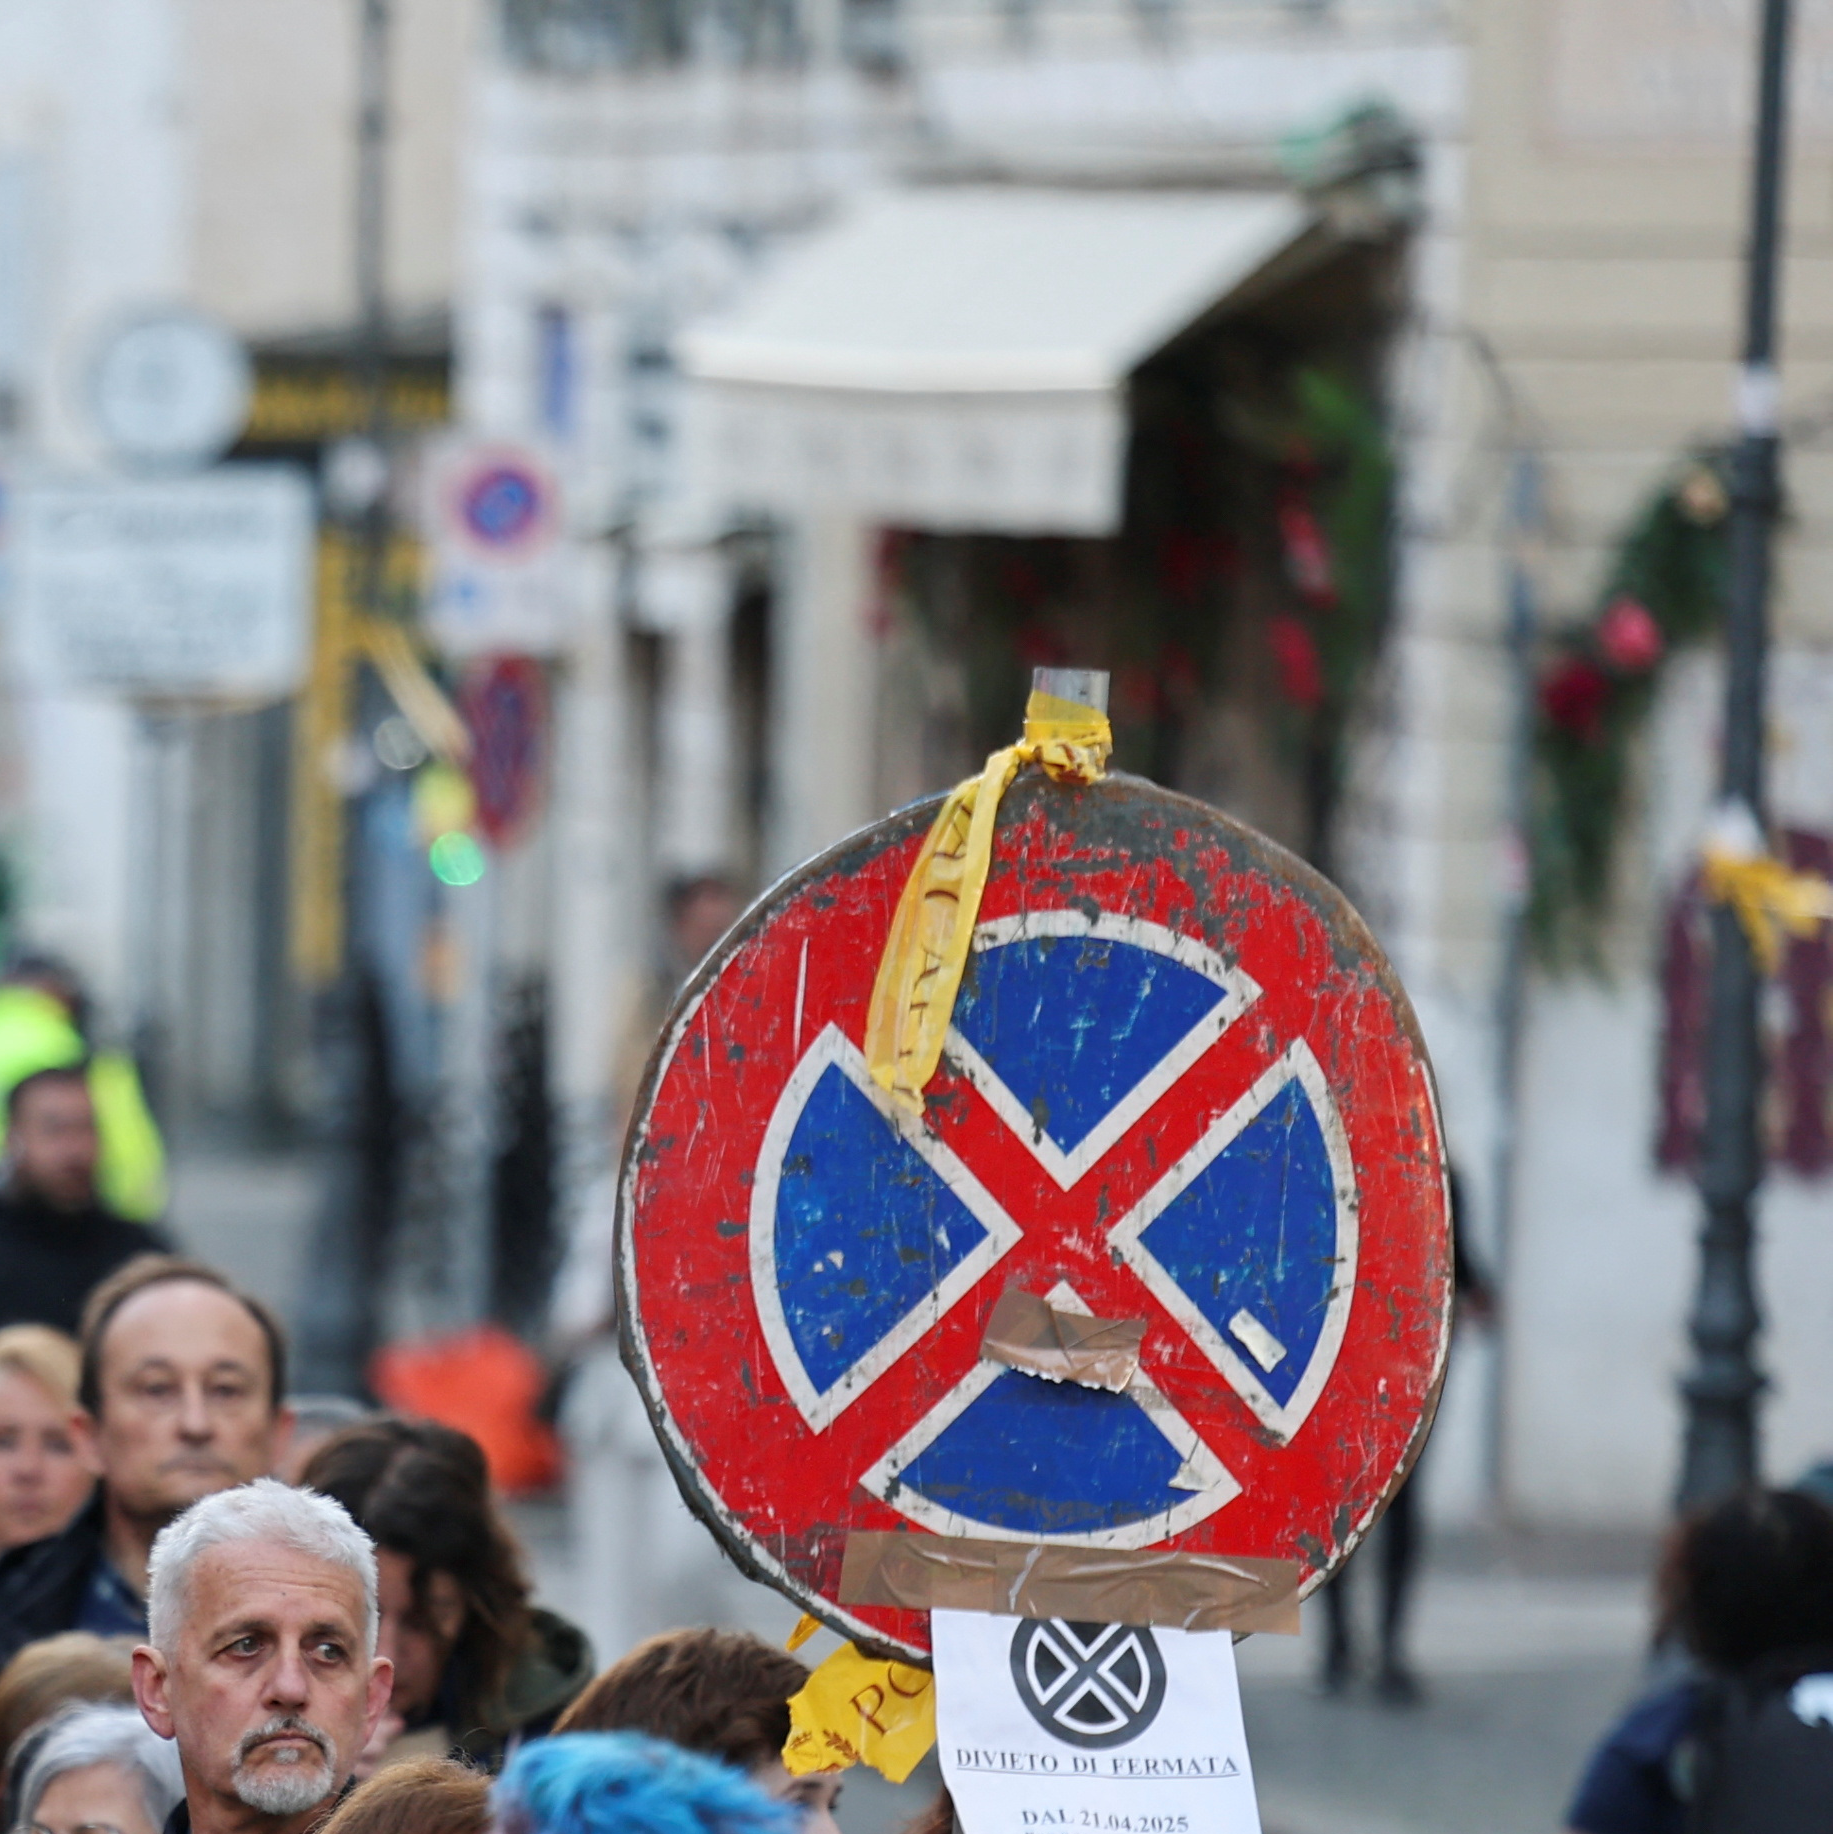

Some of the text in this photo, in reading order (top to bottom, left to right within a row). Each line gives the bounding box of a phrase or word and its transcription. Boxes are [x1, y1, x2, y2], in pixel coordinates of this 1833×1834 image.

[956, 1749, 1240, 1776] DIVIETO DI FERMATA
[1022, 1809, 1189, 1834] DAL 21.04.2025
